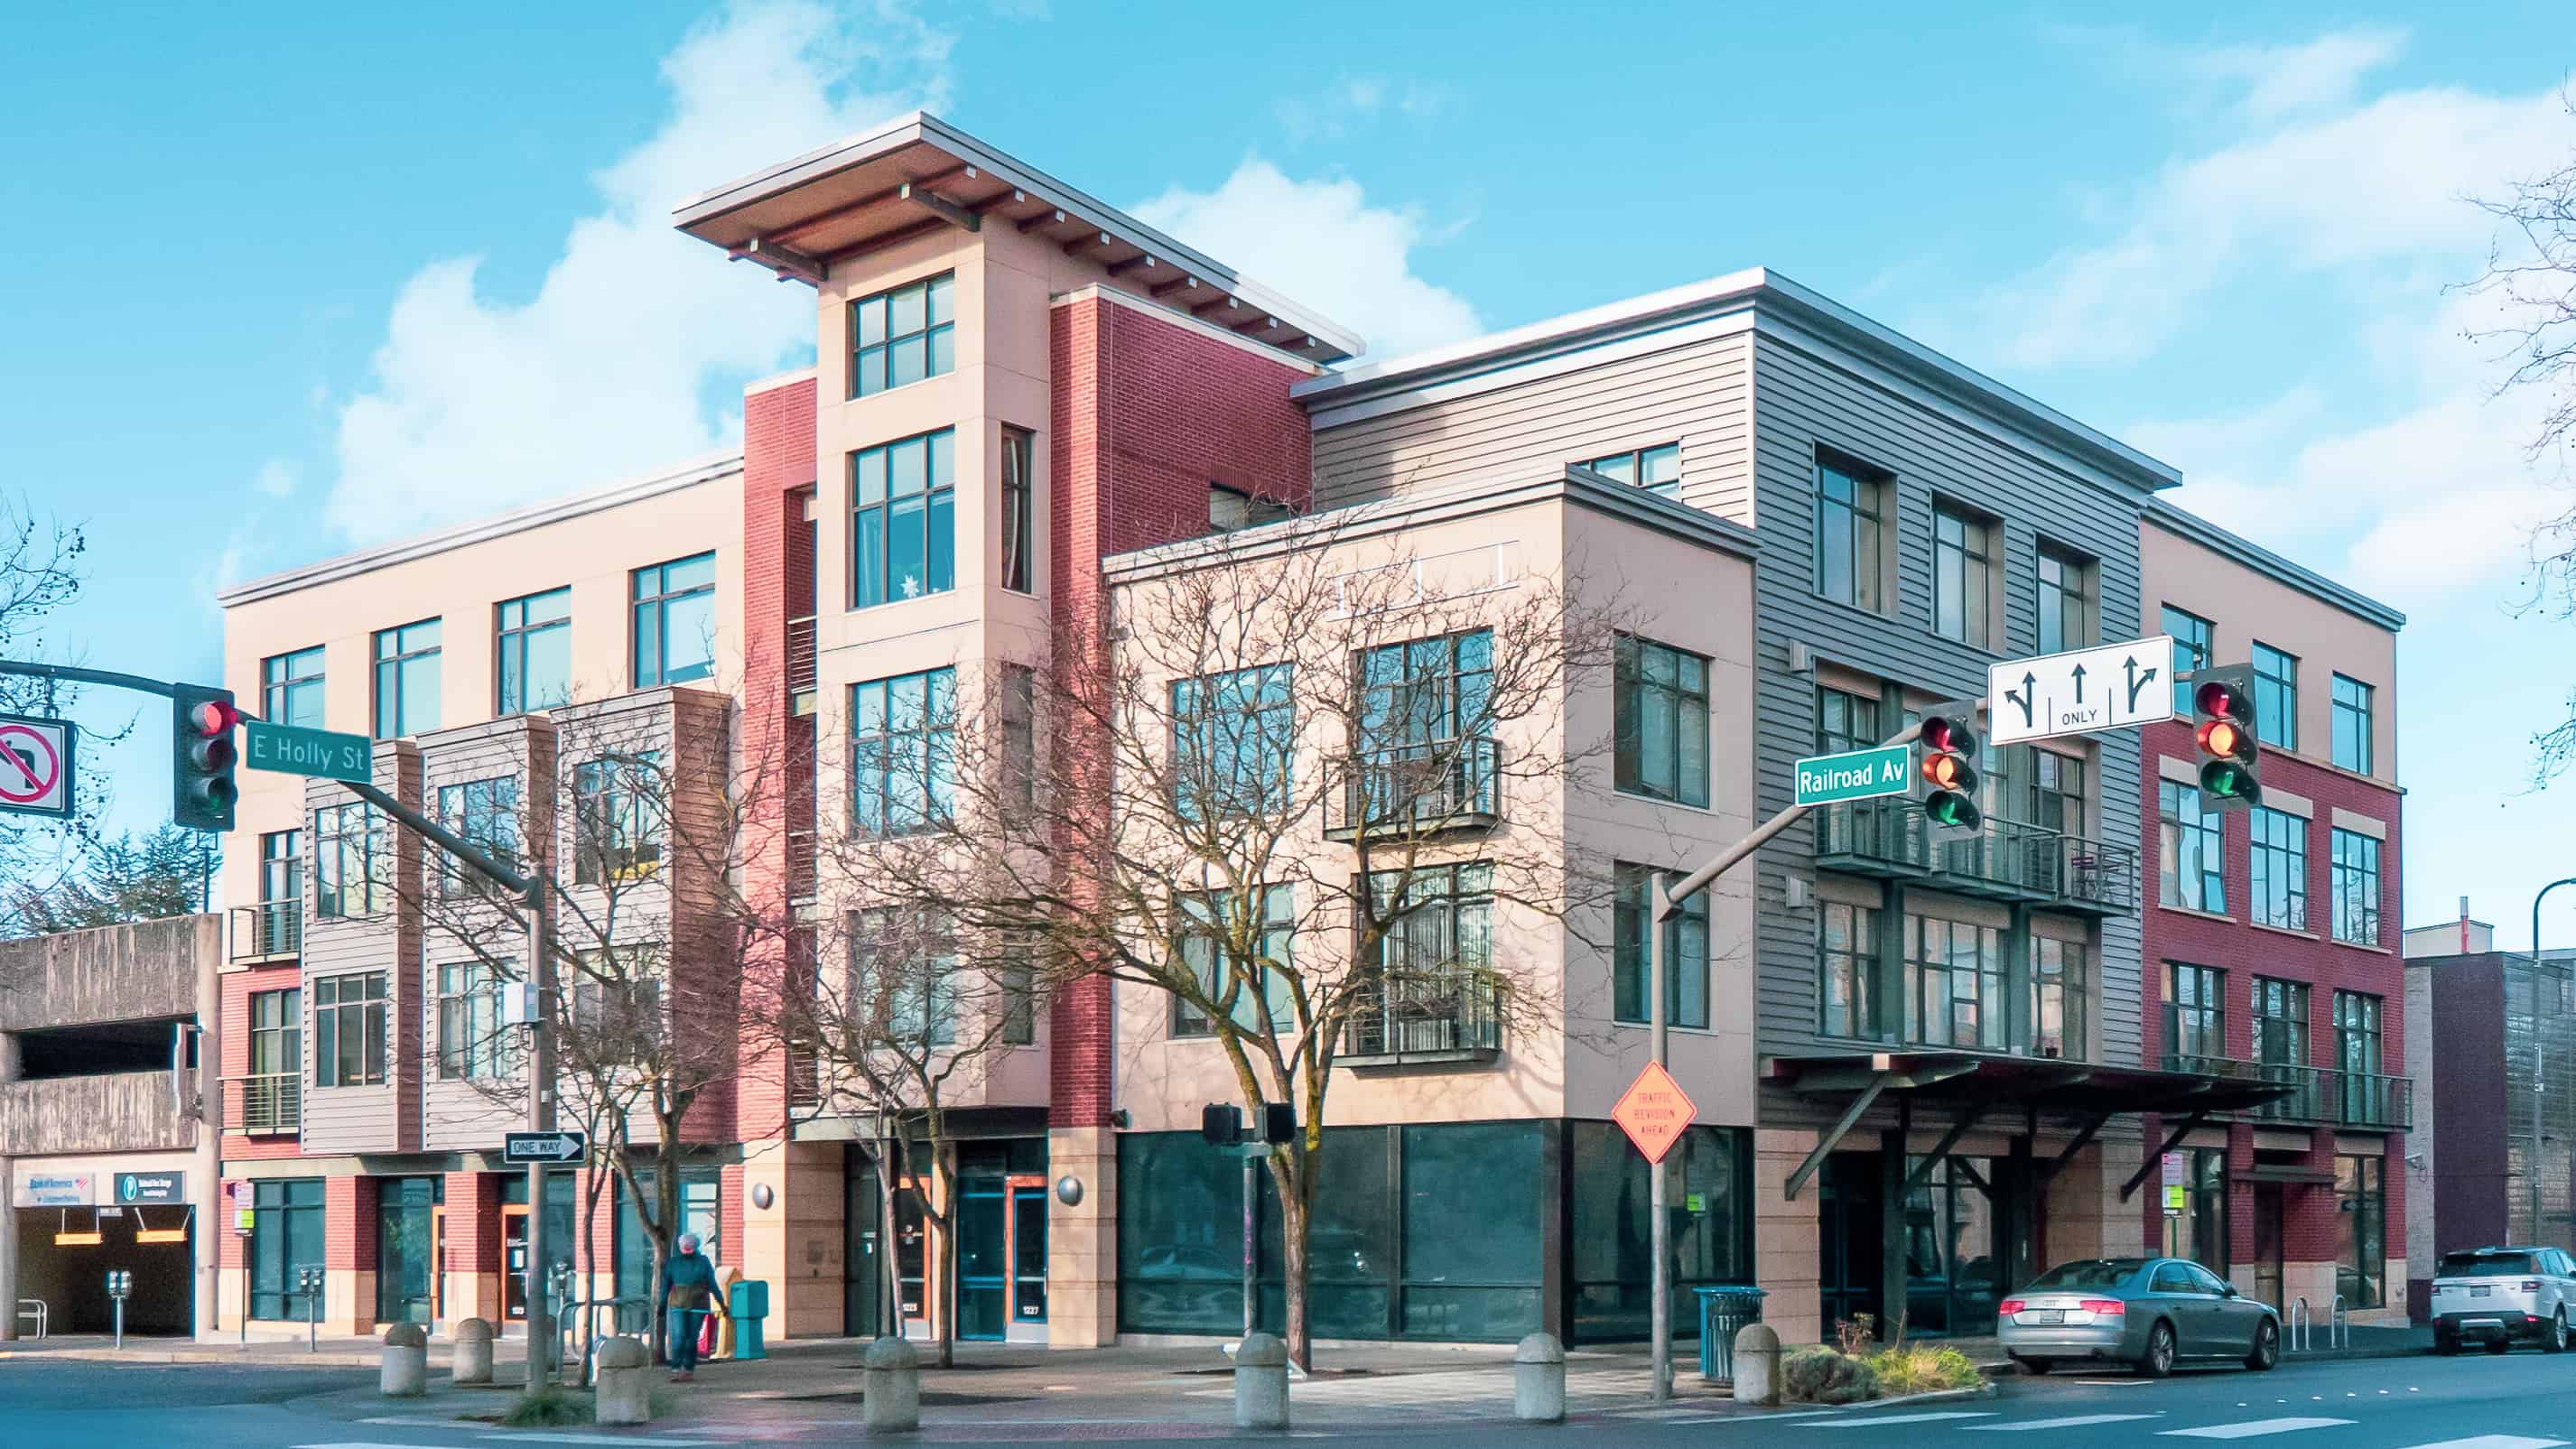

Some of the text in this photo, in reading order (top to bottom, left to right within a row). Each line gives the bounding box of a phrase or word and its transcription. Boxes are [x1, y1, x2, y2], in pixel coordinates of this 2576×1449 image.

[2061, 709, 2097, 725] ONLY
[255, 735, 364, 772] E Holly St
[1799, 759, 1904, 794] Railroad Av
[1638, 1092, 1672, 1103] TRAFFIC
[1641, 1125, 1669, 1136] AHEAD
[514, 1141, 561, 1153] ONE WAY
